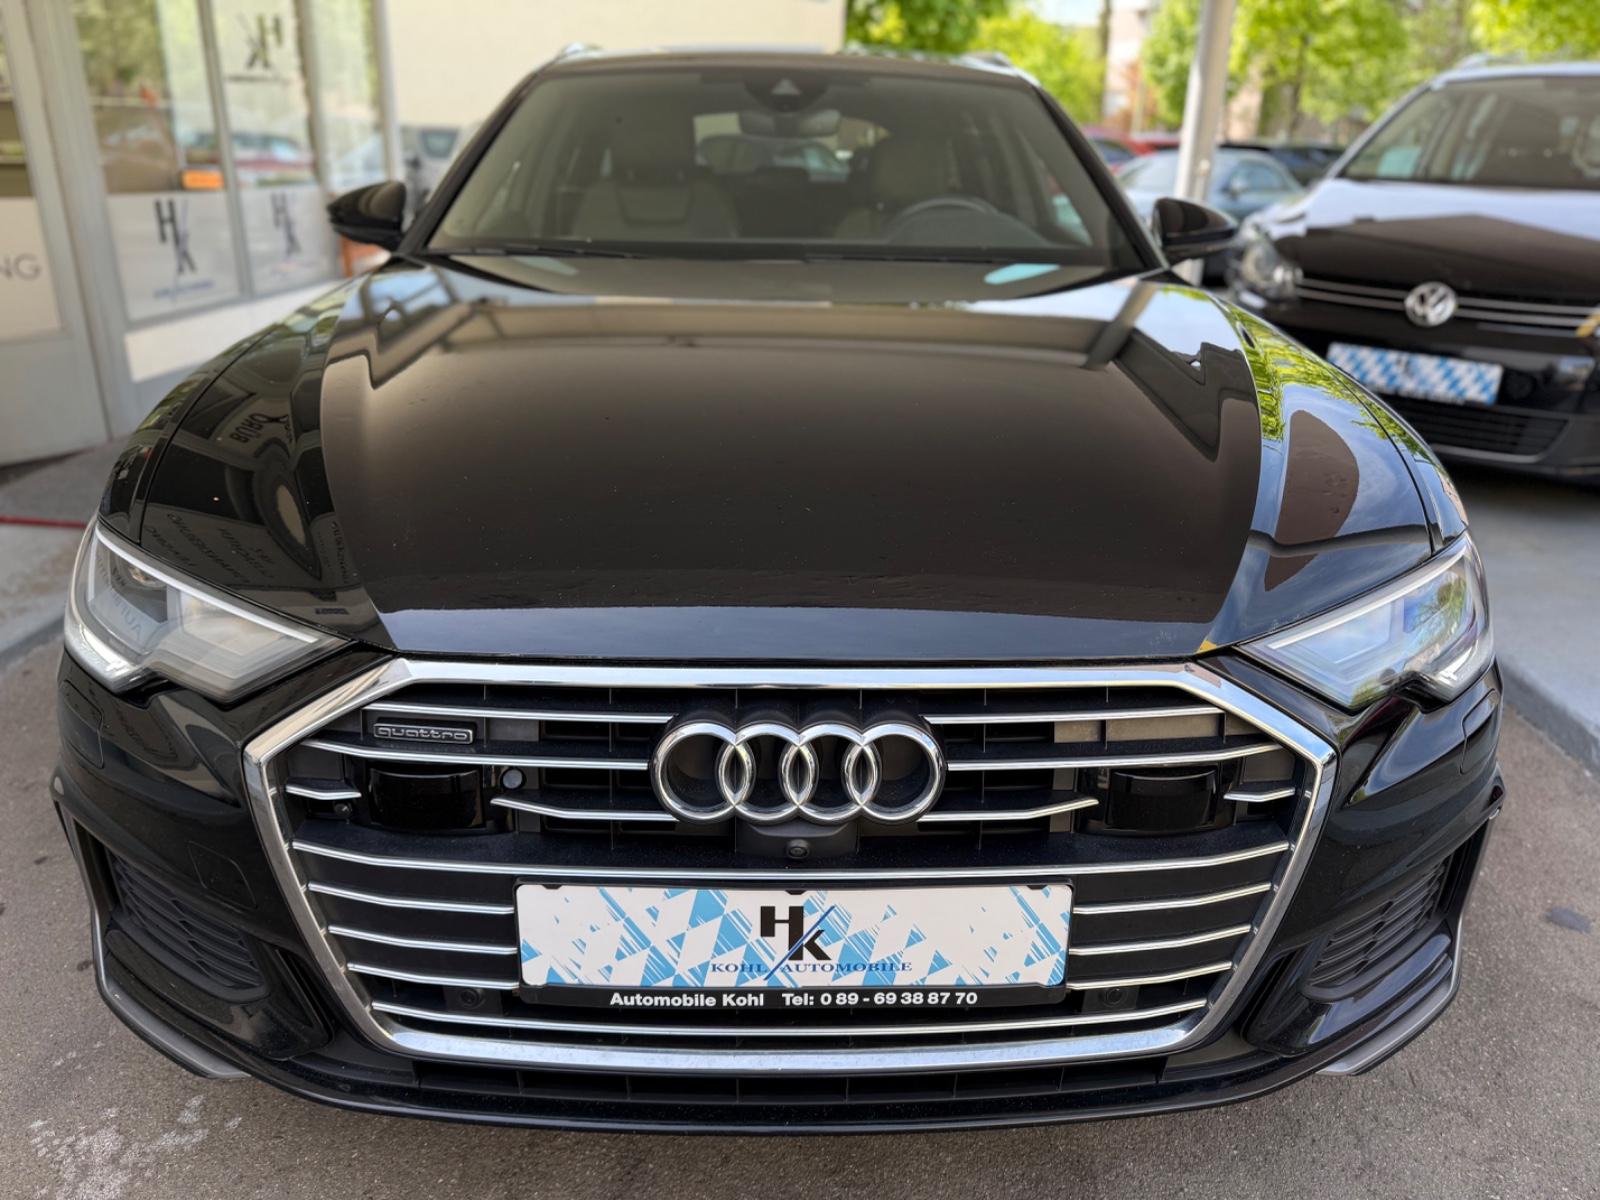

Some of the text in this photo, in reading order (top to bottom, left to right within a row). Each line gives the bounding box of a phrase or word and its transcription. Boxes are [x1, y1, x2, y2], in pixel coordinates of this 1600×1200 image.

[378, 727, 468, 740] quattro
[711, 962, 913, 973] KOHL AUTOMOBILE
[610, 992, 717, 1007] Automobile
[722, 993, 764, 1007] Kohl
[782, 993, 815, 1006] Tel:
[820, 993, 832, 1005] 0
[835, 992, 859, 1005] 89
[873, 992, 898, 1005] 69
[900, 992, 924, 1005] 38
[927, 992, 951, 1005] 87
[955, 992, 978, 1005] 70
